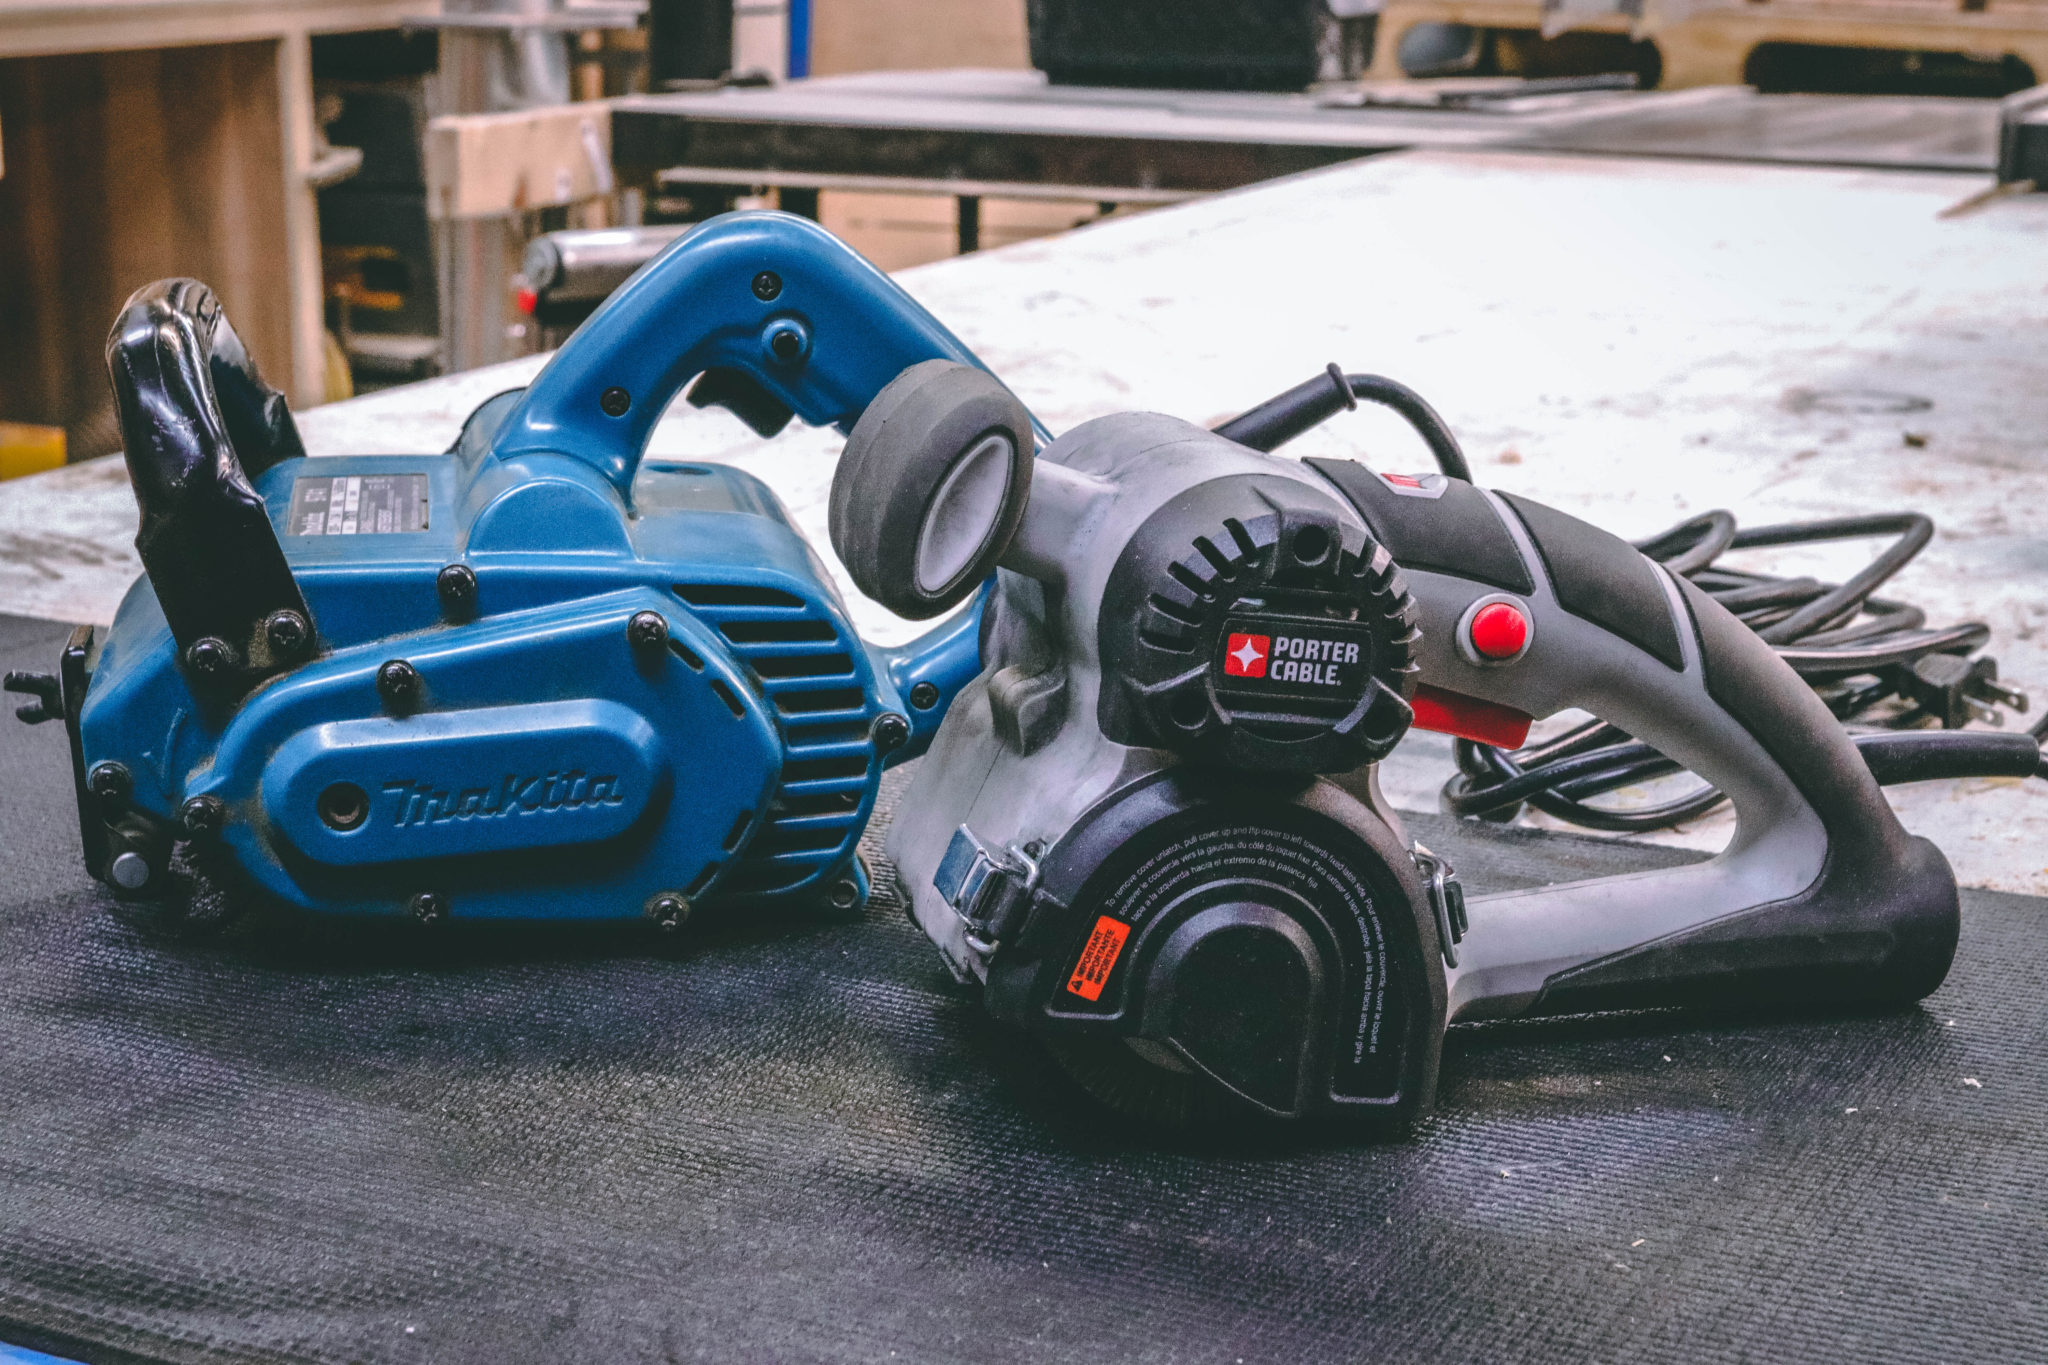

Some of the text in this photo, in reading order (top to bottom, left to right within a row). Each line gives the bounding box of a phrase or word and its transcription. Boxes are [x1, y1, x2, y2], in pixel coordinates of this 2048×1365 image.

[1274, 636, 1360, 663] PORTER
[382, 768, 624, 828] Makita
[1183, 836, 1198, 849] pull
[1198, 830, 1219, 842] cover
[1221, 828, 1231, 838] up
[1232, 826, 1248, 835] and
[1136, 857, 1155, 876] cover
[1140, 880, 1149, 889] le
[1148, 858, 1180, 883] couvercle
[1197, 848, 1205, 857] la
[1237, 840, 1247, 849] du
[1265, 842, 1275, 852] du
[1312, 860, 1327, 876] Para
[1114, 873, 1137, 898] remove
[1131, 906, 1146, 922] tapa
[1148, 892, 1158, 900] la
[1157, 870, 1190, 894] izquierda
[1190, 862, 1213, 874] hacia
[1214, 858, 1222, 866] el
[1224, 856, 1256, 865] extremo
[1256, 856, 1266, 866] de
[1268, 858, 1276, 868] la
[1276, 862, 1306, 880] palanca
[1105, 899, 1116, 908] To
[1364, 898, 1376, 916] Pour
[1371, 916, 1384, 942] enlever
[1077, 930, 1102, 976] IMPORTANT
[1086, 928, 1114, 981] IMPORTANTE
[1094, 938, 1120, 984] IMPORTANT
[1375, 1012, 1382, 1020] le
